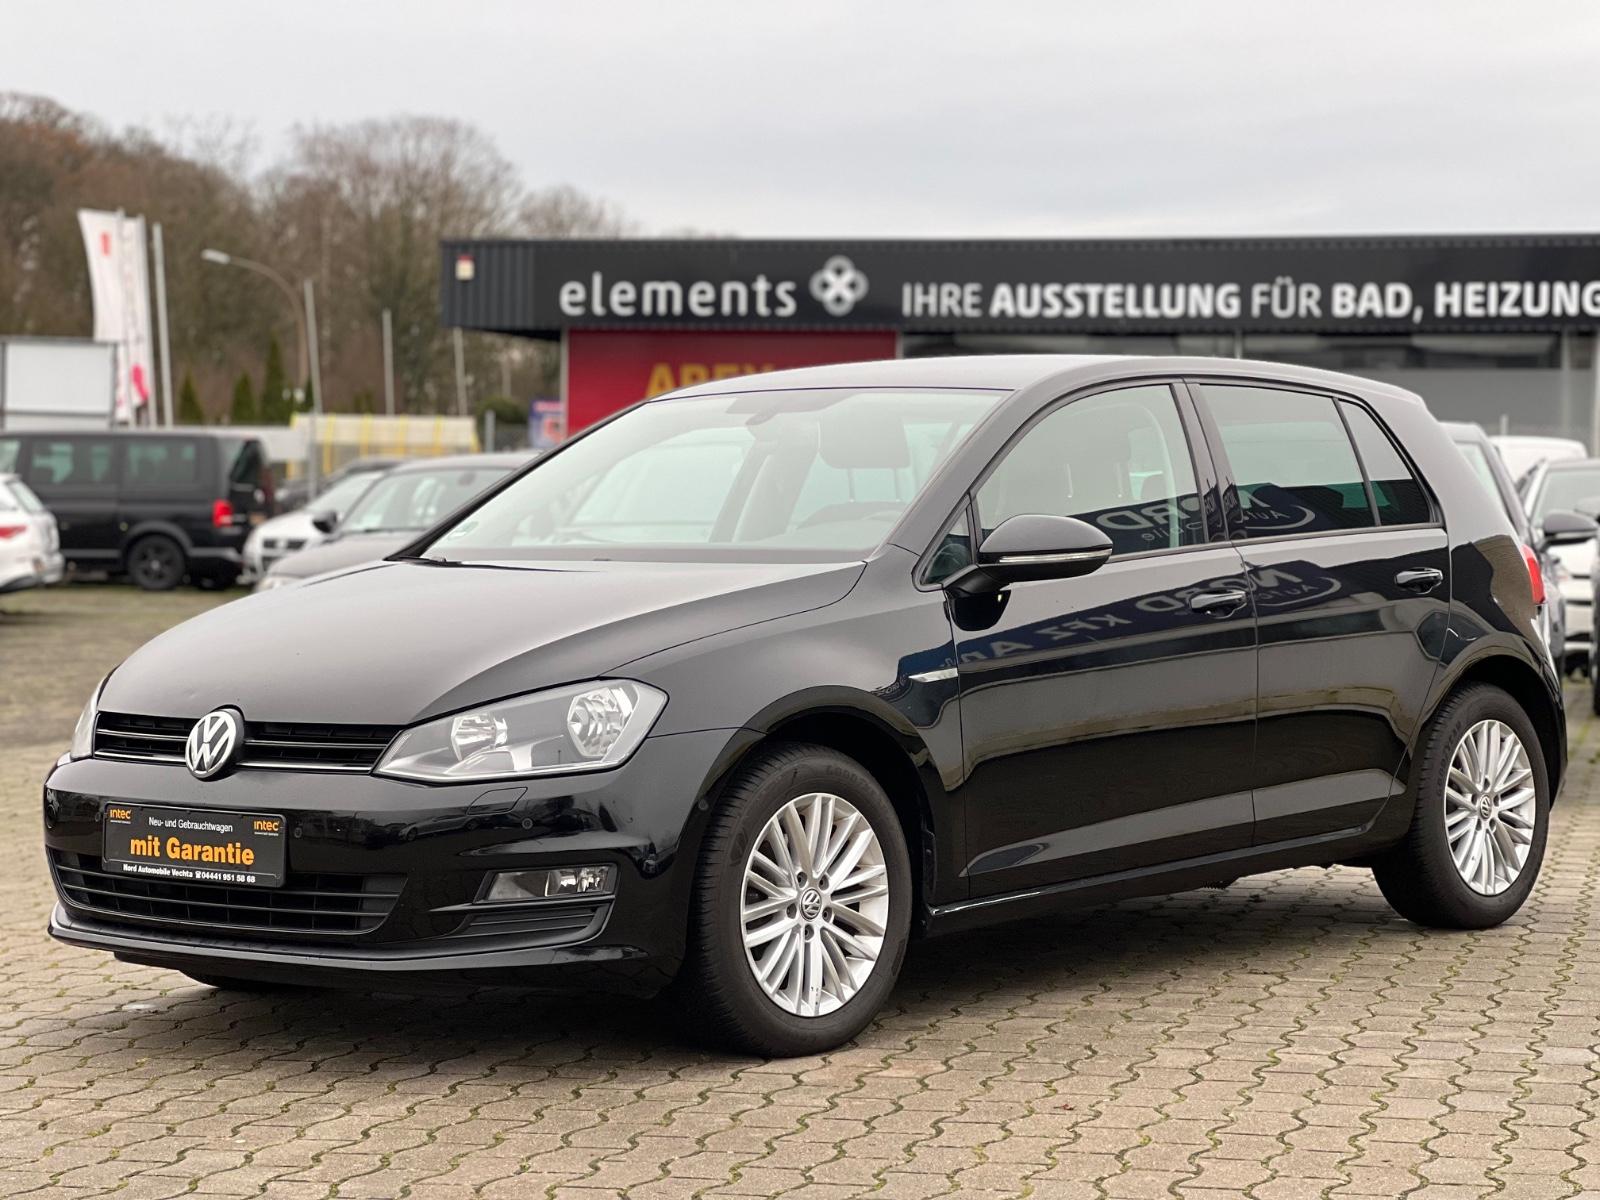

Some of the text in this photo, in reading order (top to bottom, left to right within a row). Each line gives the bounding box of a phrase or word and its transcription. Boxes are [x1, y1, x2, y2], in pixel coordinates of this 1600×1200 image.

[559, 271, 797, 317] elements
[902, 276, 1600, 324] IHRE AUSSTELLUNG FÜR BAD, HEIZUNG
[148, 816, 233, 834] Neu- und Gebrauchtwagen
[254, 820, 280, 831] intec
[130, 835, 255, 866] mit Garantie
[123, 863, 137, 873] Nord
[138, 866, 171, 876] Automobile
[171, 869, 193, 878] Vechta
